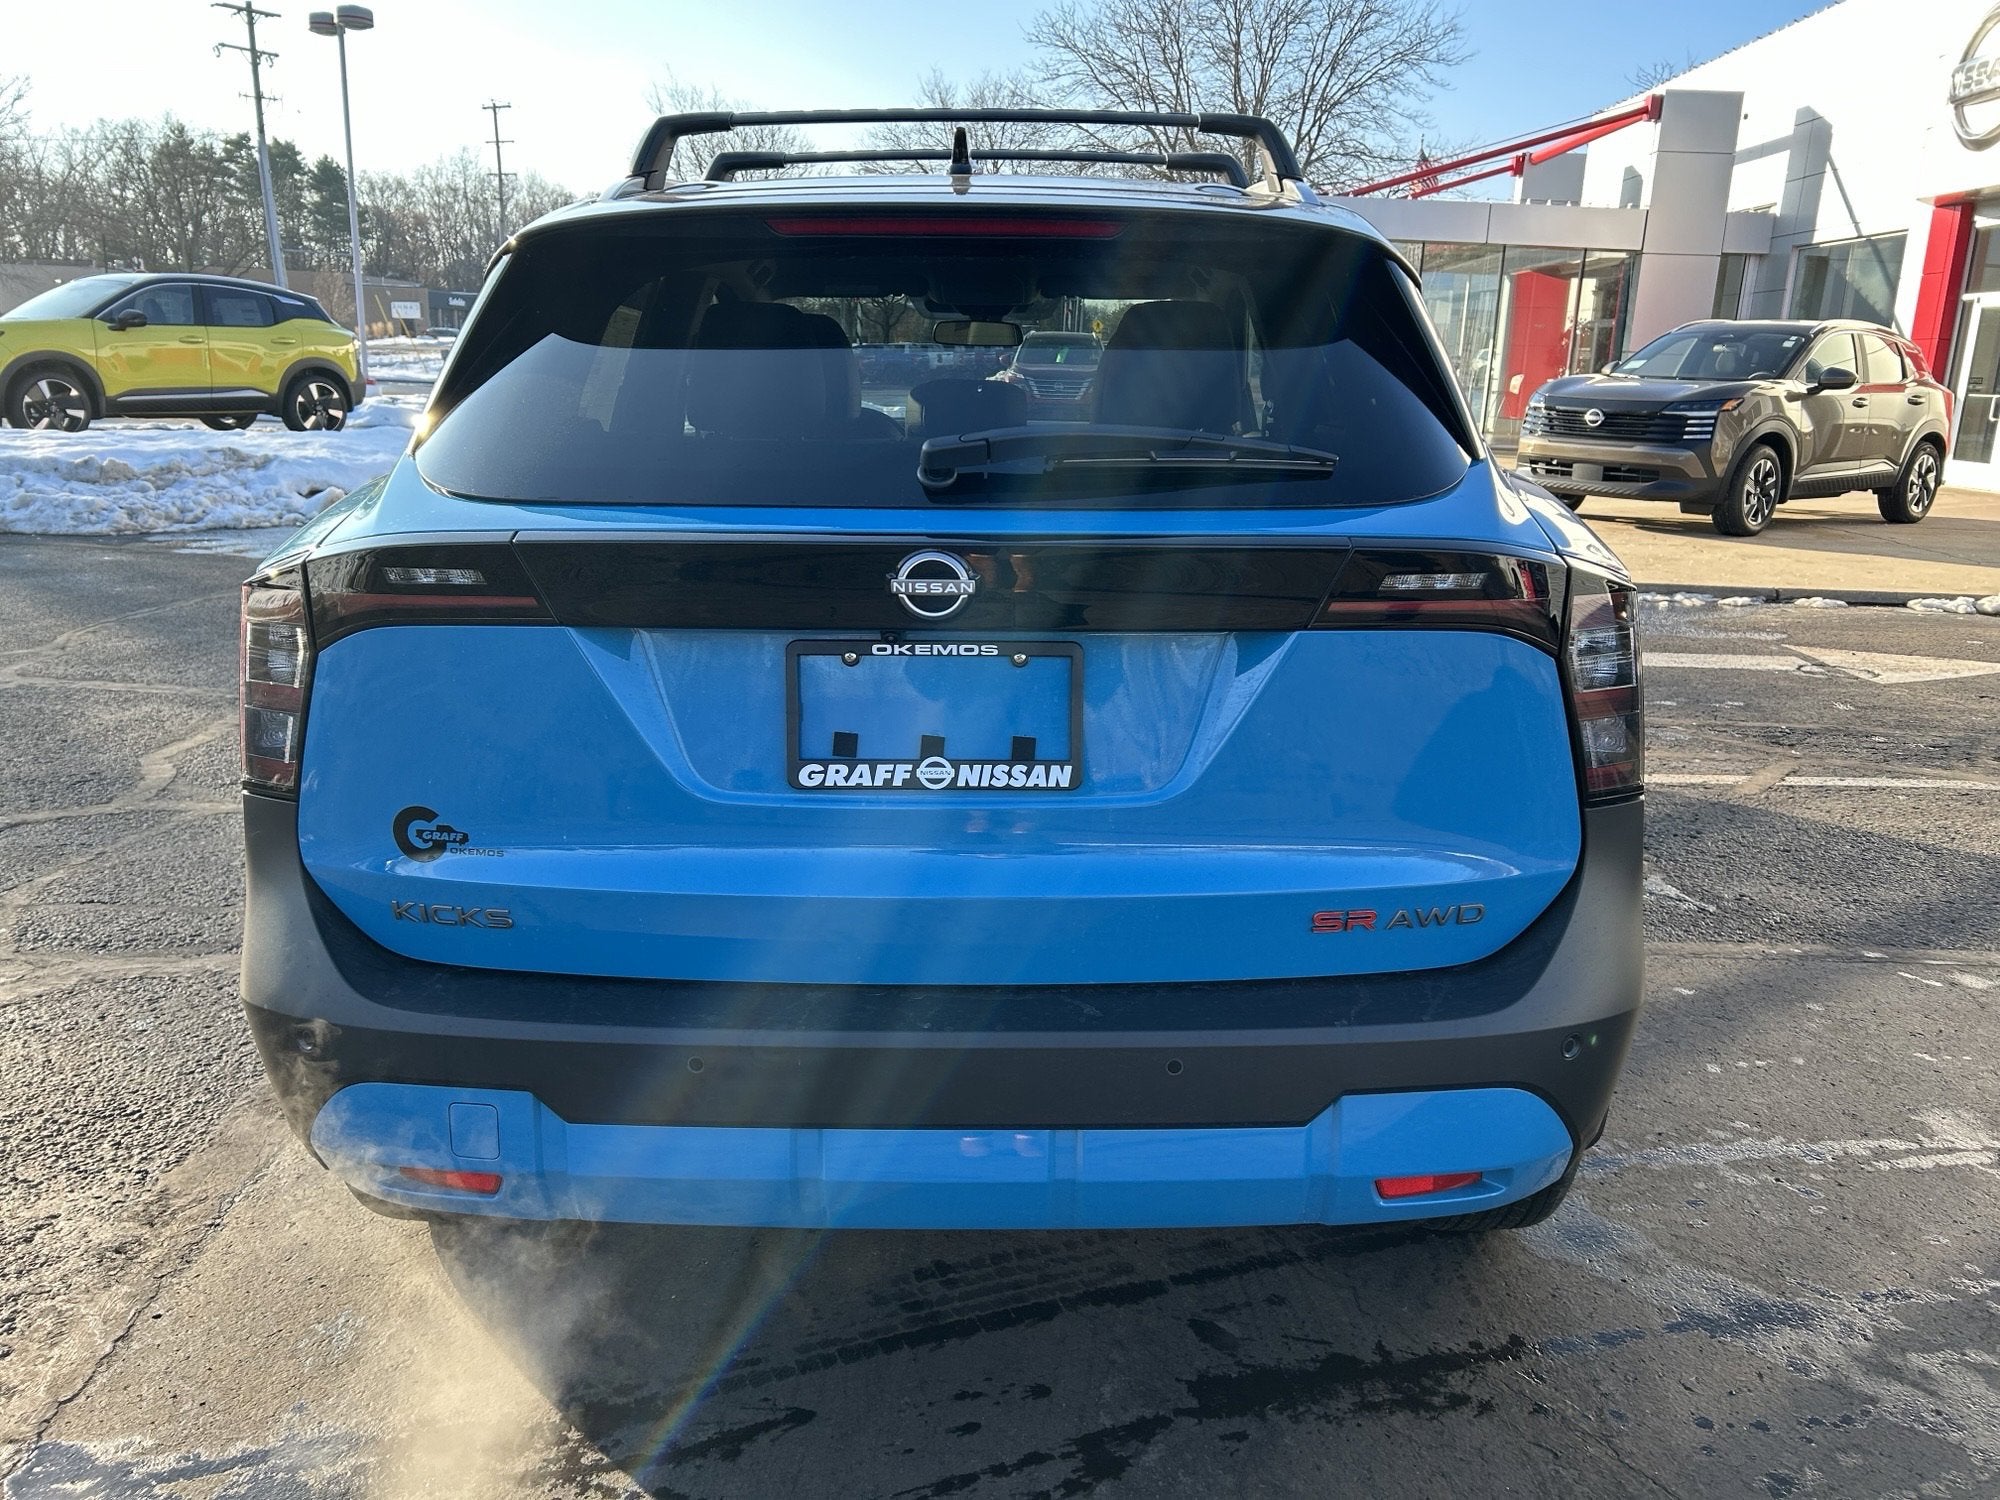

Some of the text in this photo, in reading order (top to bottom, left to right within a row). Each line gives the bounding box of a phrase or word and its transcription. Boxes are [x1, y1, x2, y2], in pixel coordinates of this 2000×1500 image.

[892, 581, 975, 594] NISSAN
[871, 643, 999, 656] OKEMOS
[798, 763, 913, 787] GRAFF
[957, 764, 1072, 788] NISSAN
[422, 831, 464, 841] GRAFF
[449, 847, 505, 858] OKEMOS
[391, 900, 515, 929] KICKS
[1311, 903, 1486, 934] SR AWD
